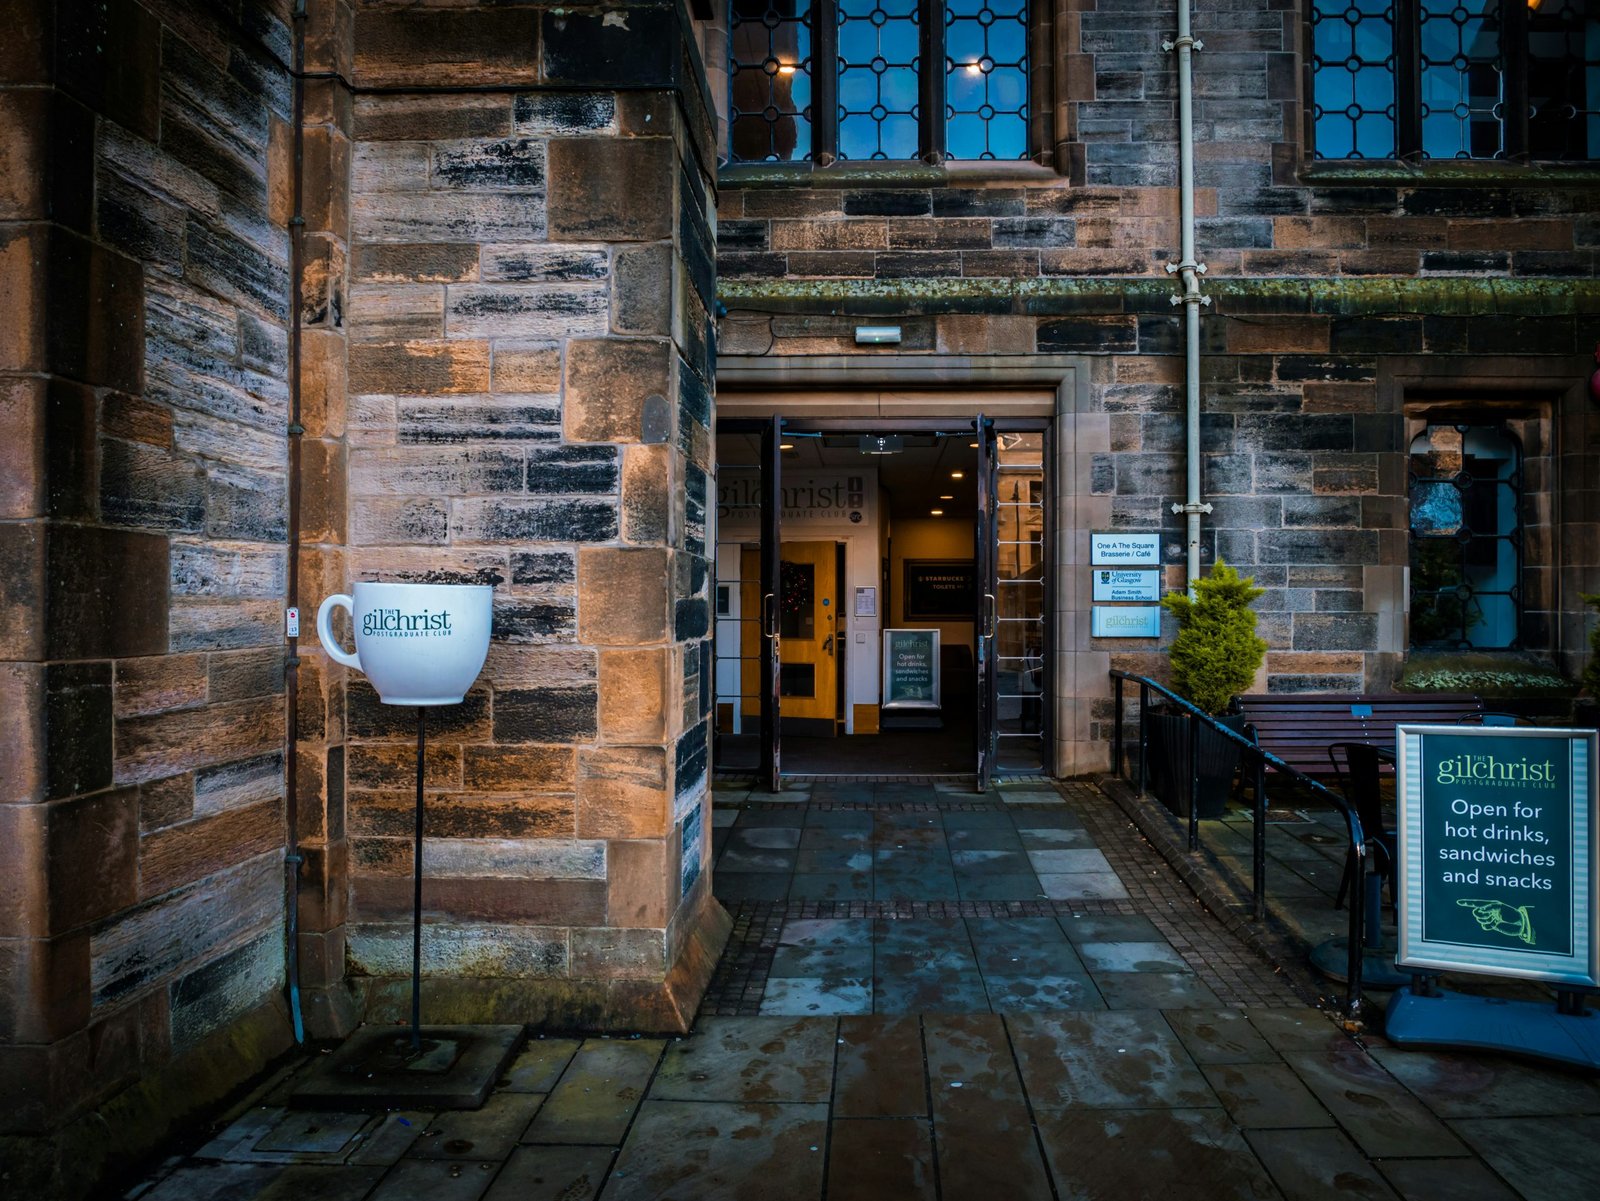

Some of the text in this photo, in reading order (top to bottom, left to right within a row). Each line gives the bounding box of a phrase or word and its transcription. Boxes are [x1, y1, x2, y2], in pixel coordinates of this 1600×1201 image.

[363, 609, 452, 636] gilchrist
[1105, 616, 1149, 628] gilchrist
[899, 653, 916, 661] Open
[1437, 754, 1556, 784] gilchrist
[1455, 779, 1526, 788] POSTGRADUATE
[1451, 799, 1543, 819] Open for
[1445, 821, 1549, 845] hot drinks,
[1439, 846, 1556, 867] sandwiches
[1443, 868, 1552, 890] and snacks
